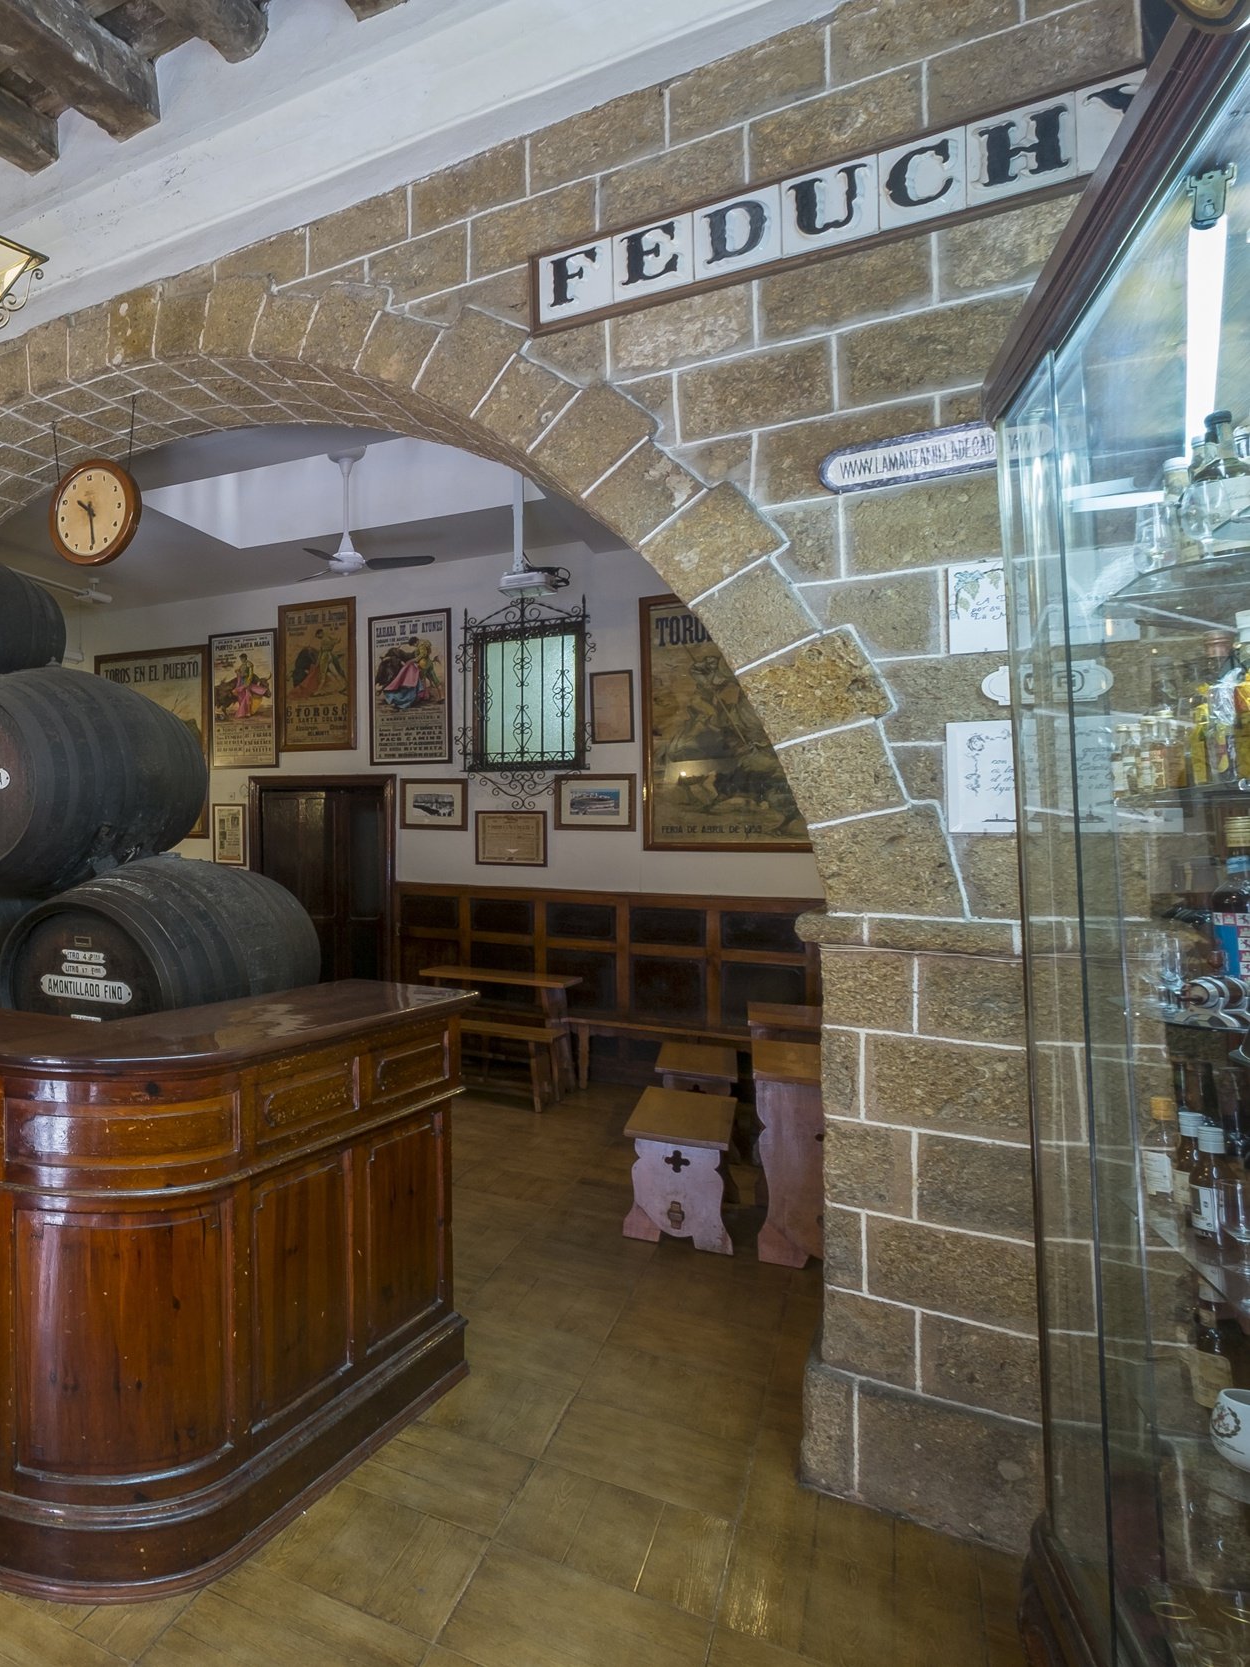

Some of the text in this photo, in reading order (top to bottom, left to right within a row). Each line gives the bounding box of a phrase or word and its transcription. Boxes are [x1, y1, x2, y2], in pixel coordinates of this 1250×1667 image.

[655, 614, 713, 647] TORO
[104, 661, 199, 684] TOROS EN EL PUERTO
[295, 706, 338, 717] TOROS
[48, 978, 122, 1000] AMONTILLADO FINO
